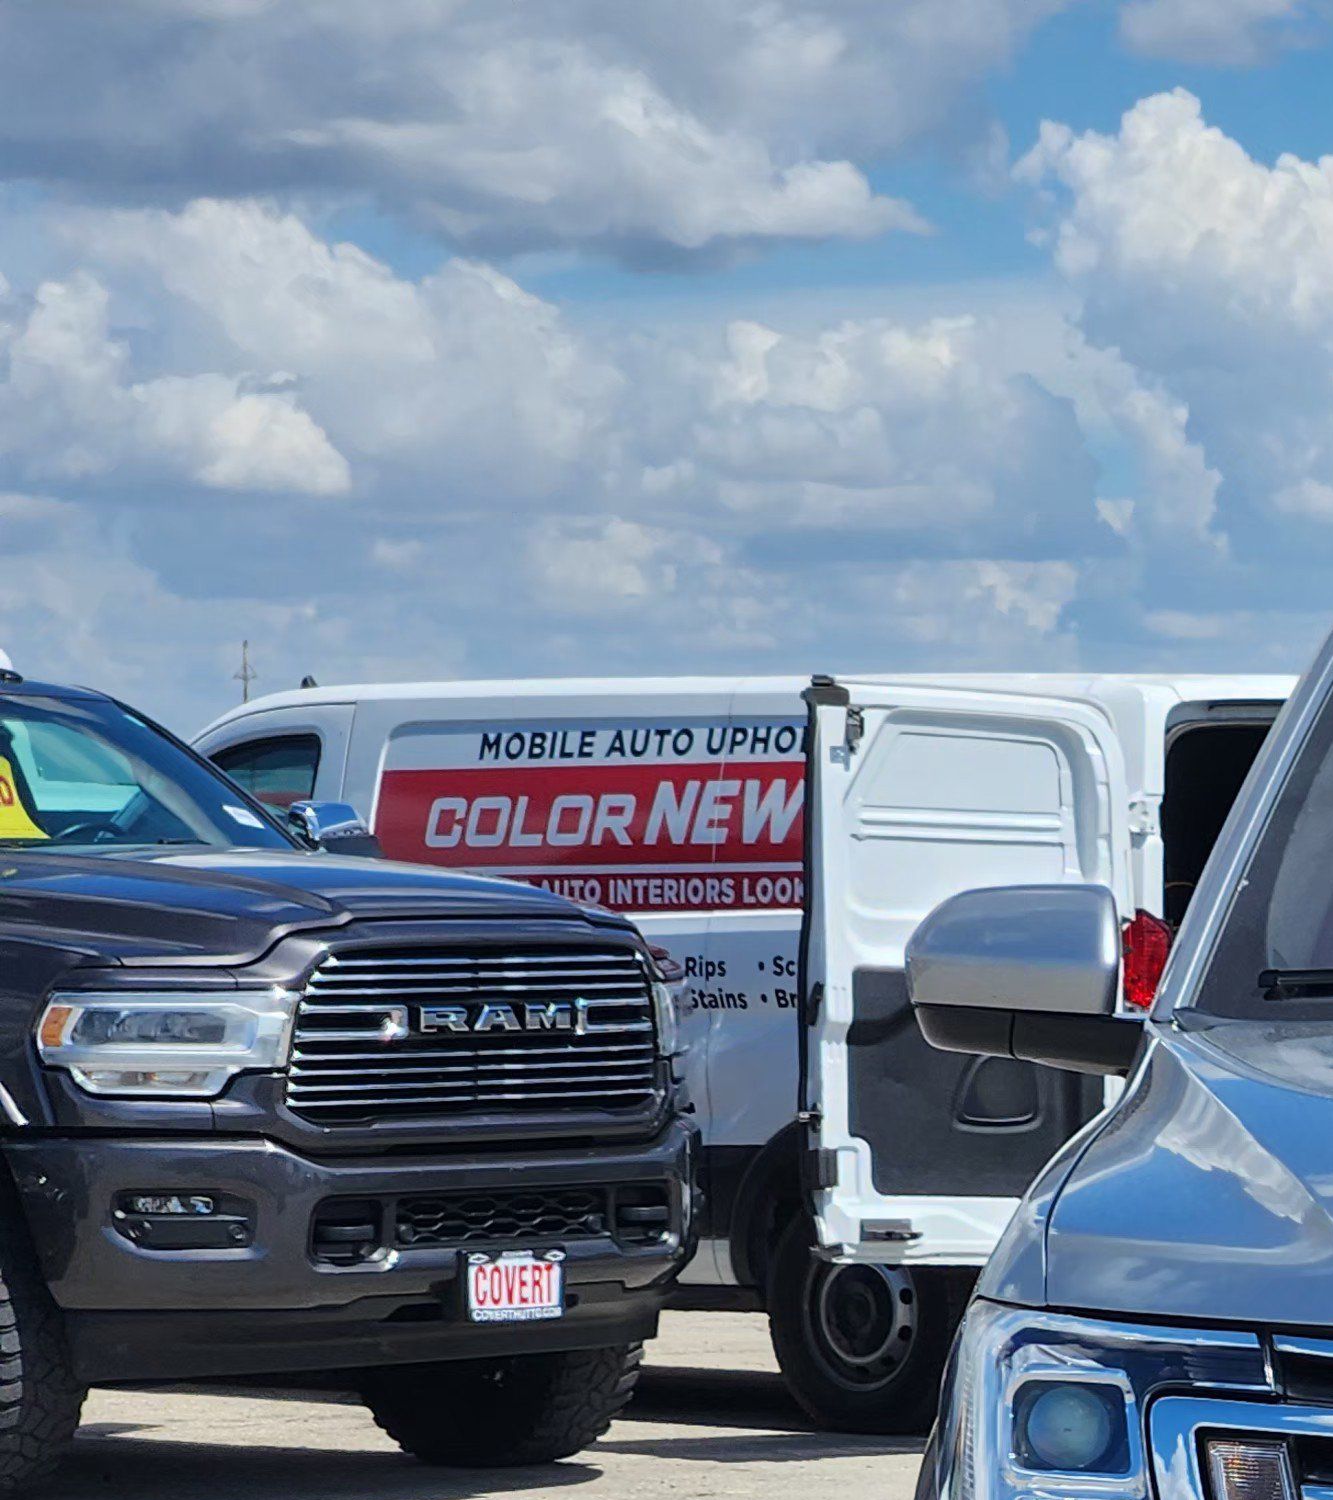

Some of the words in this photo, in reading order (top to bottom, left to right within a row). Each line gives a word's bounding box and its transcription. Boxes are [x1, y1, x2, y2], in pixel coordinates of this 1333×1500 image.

[479, 730, 597, 760] MOBILE
[605, 728, 694, 757] AUTO
[424, 794, 634, 848] COLOR
[644, 778, 805, 846] NEW
[609, 878, 735, 905] INTERIORS
[685, 956, 727, 982] Rips
[420, 1003, 572, 1033] RAM
[474, 1264, 554, 1306] COVERT
